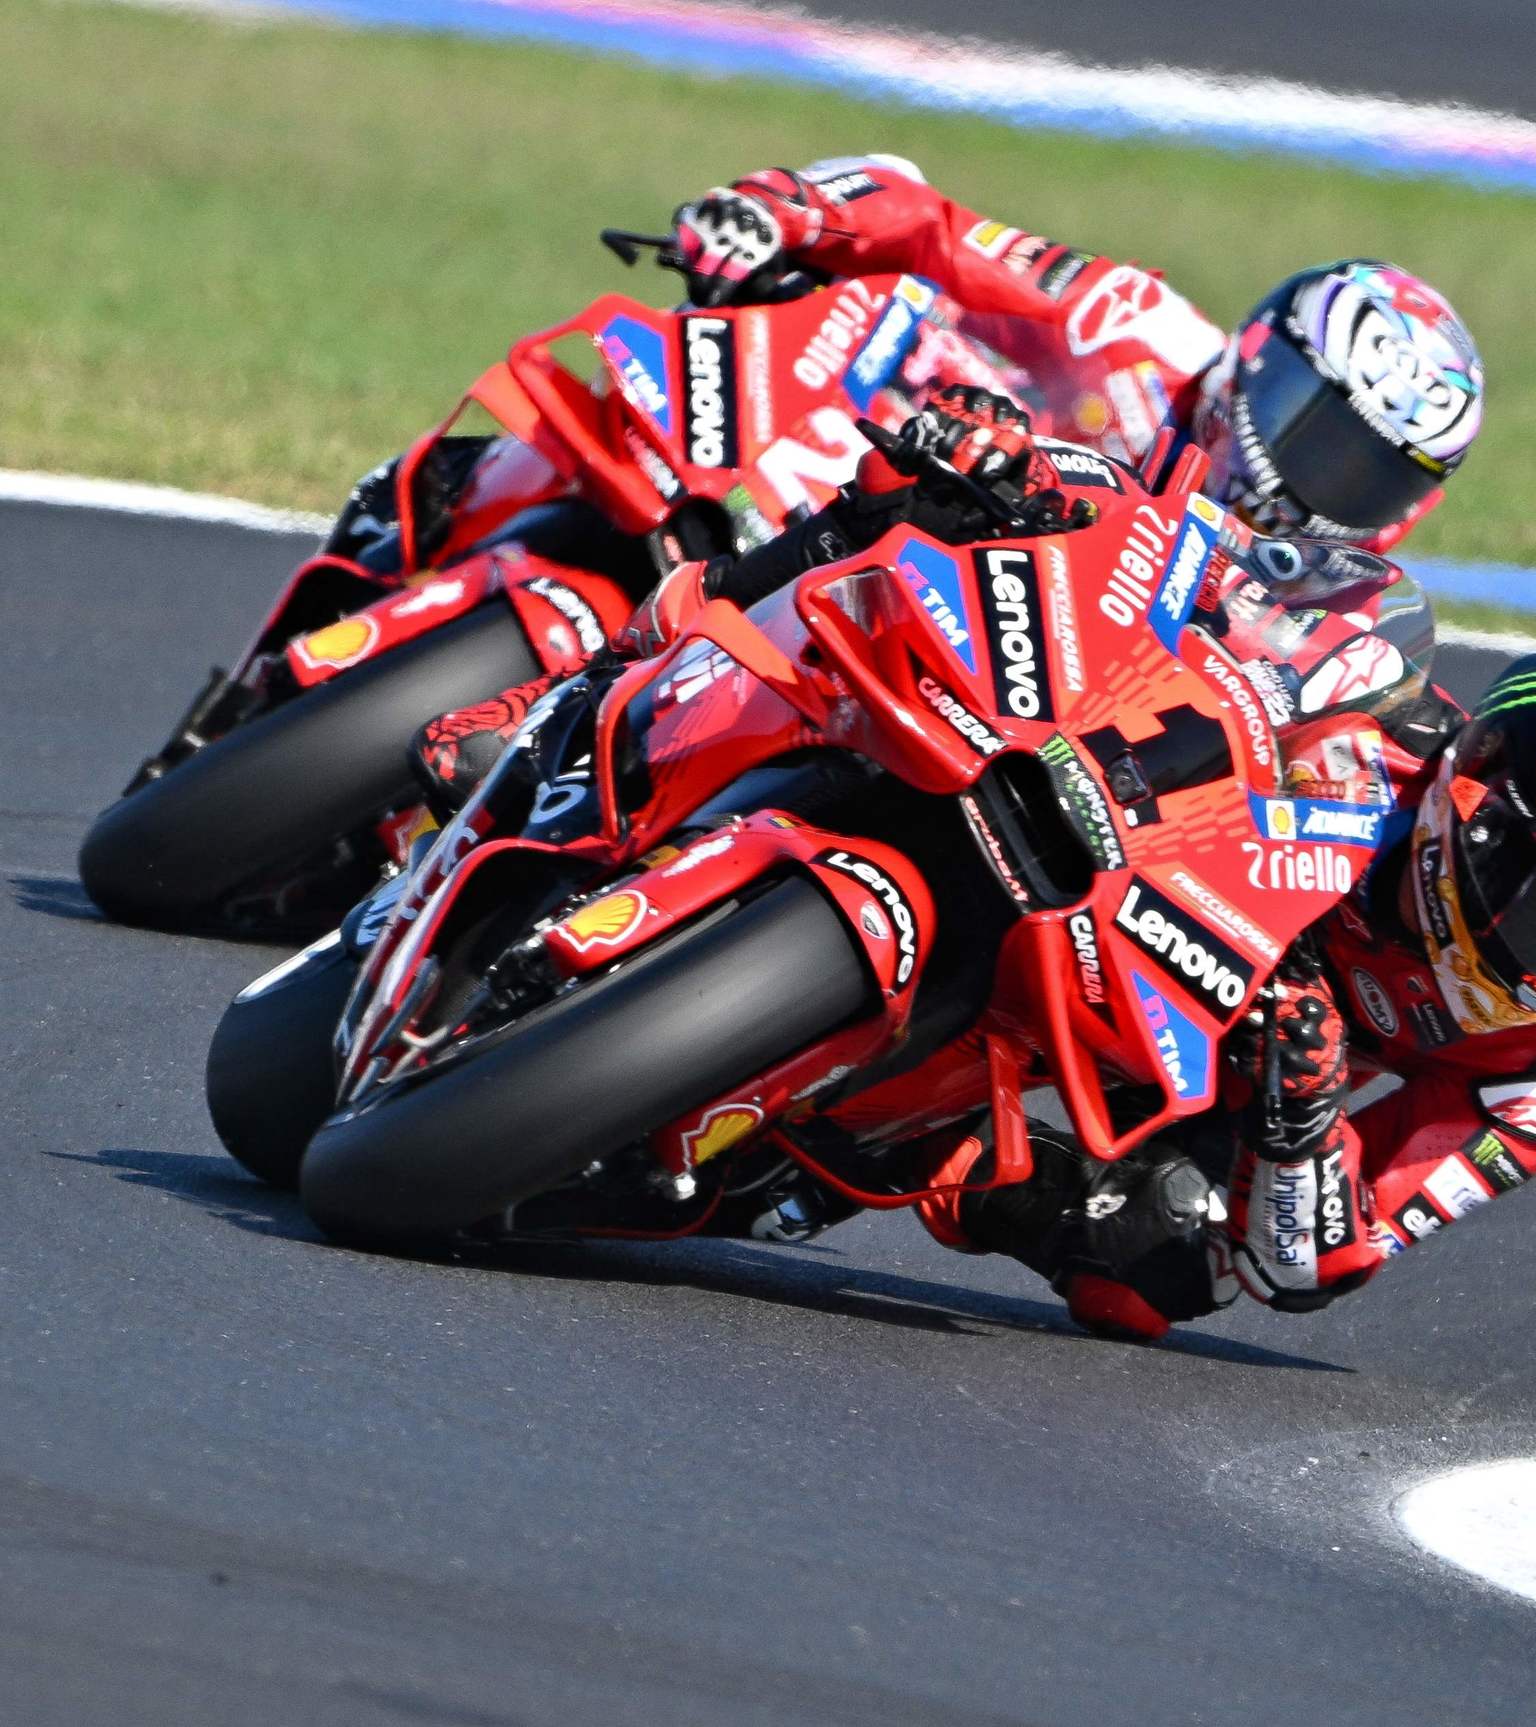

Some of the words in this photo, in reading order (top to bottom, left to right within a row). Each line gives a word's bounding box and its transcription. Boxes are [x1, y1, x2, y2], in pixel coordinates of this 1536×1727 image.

[623, 356, 668, 413] TIM
[687, 318, 724, 467] Lenovo
[757, 407, 874, 510] 2
[922, 587, 969, 646] TIM
[986, 550, 1040, 718] Lenovo
[918, 677, 1009, 755] CARRERA
[1203, 655, 1270, 766] VARGROUP
[826, 852, 915, 983] Lenovo
[1116, 885, 1246, 1008] Lenovo
[1156, 1029, 1189, 1092] TIM
[1266, 1163, 1308, 1266] UnipolSai
